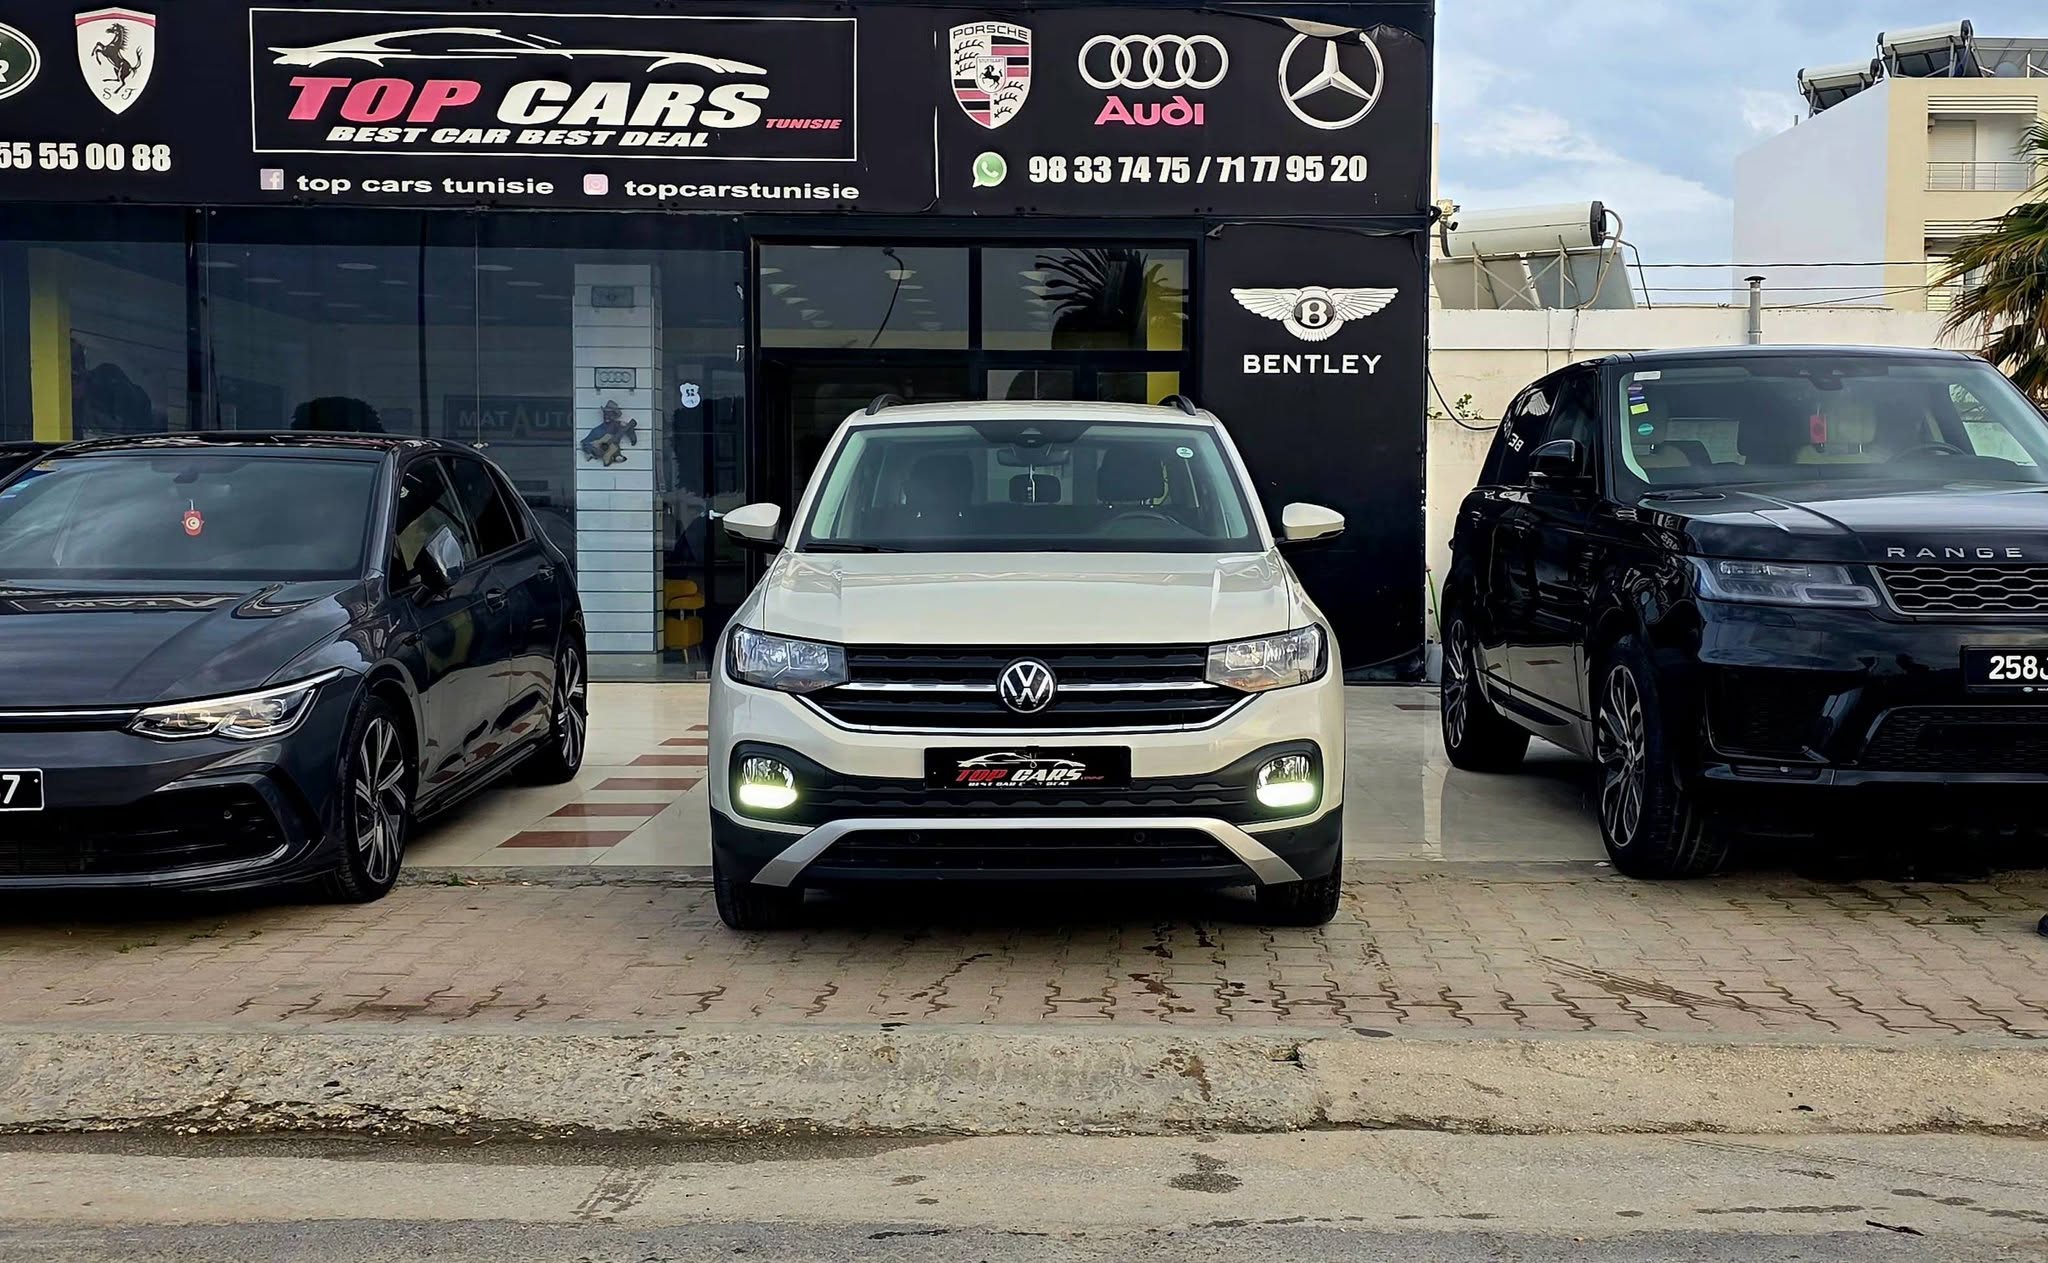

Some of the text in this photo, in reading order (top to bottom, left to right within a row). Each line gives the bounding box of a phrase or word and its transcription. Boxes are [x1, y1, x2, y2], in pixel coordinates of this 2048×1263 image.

[952, 24, 1029, 41] PORSCHE
[288, 76, 770, 129] TOP CARS
[1094, 95, 1205, 126] Audi
[765, 118, 843, 129] TUNISIE
[326, 126, 709, 148] BEST CAR BEST DEAL
[39, 142, 78, 170] 55
[85, 143, 125, 171] 00
[132, 144, 171, 172] 88
[1029, 155, 1368, 184] 98 33 74 75 / 71 77 95 20
[296, 174, 554, 194] top cars tunisie
[624, 180, 860, 200] topcarstunisie
[1243, 354, 1382, 374] BENTLEY
[1887, 547, 2023, 559] RANGE
[955, 769, 1008, 782] TOP
[1010, 768, 1085, 782] CARS
[2, 774, 21, 804] 7
